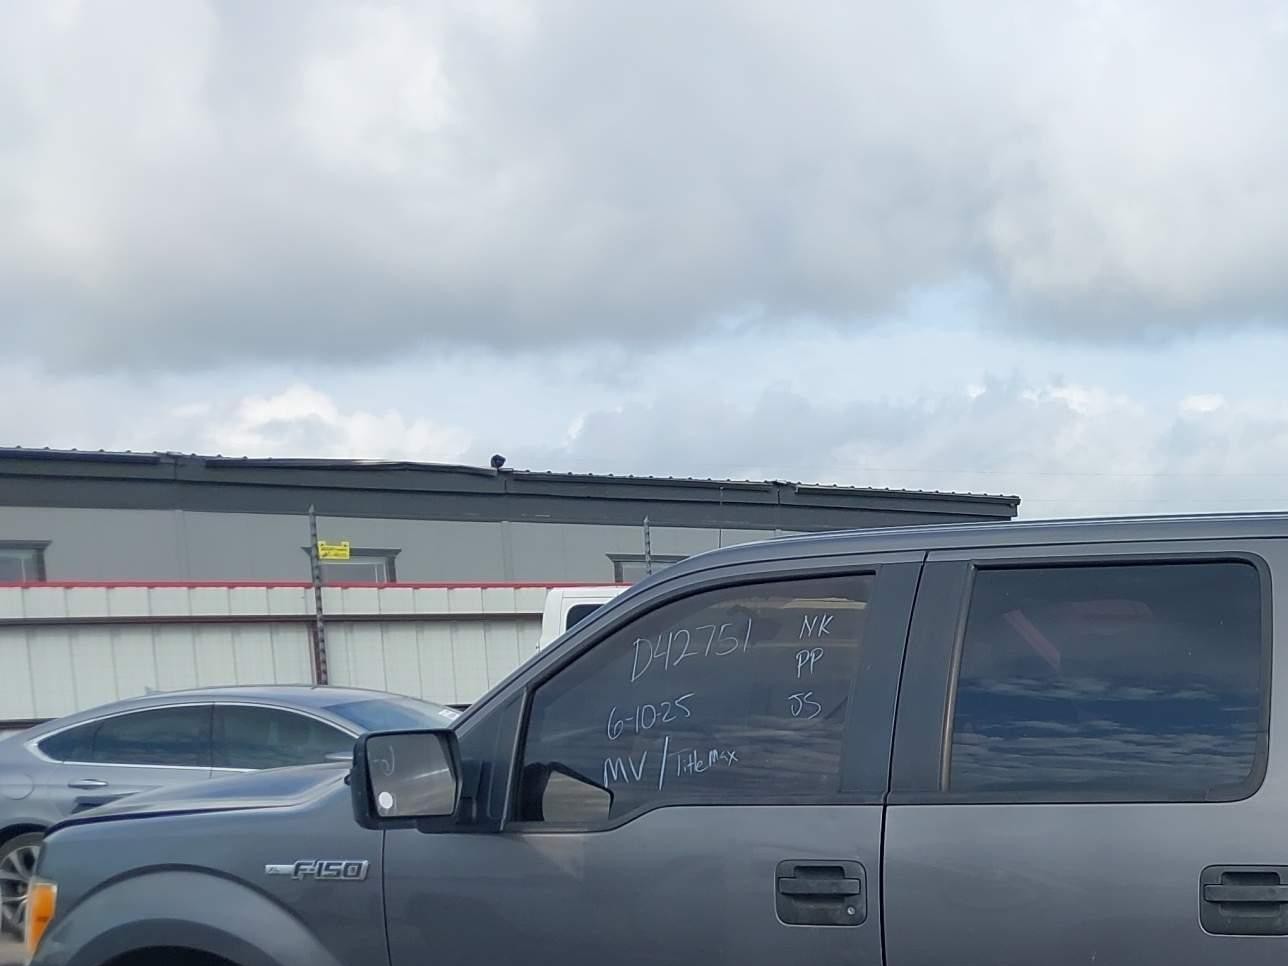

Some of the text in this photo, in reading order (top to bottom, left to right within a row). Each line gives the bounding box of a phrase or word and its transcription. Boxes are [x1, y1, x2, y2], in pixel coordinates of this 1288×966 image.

[630, 617, 752, 683] D42751
[795, 647, 824, 679] PP
[607, 692, 695, 740] 6-10-25
[787, 691, 822, 720] JS
